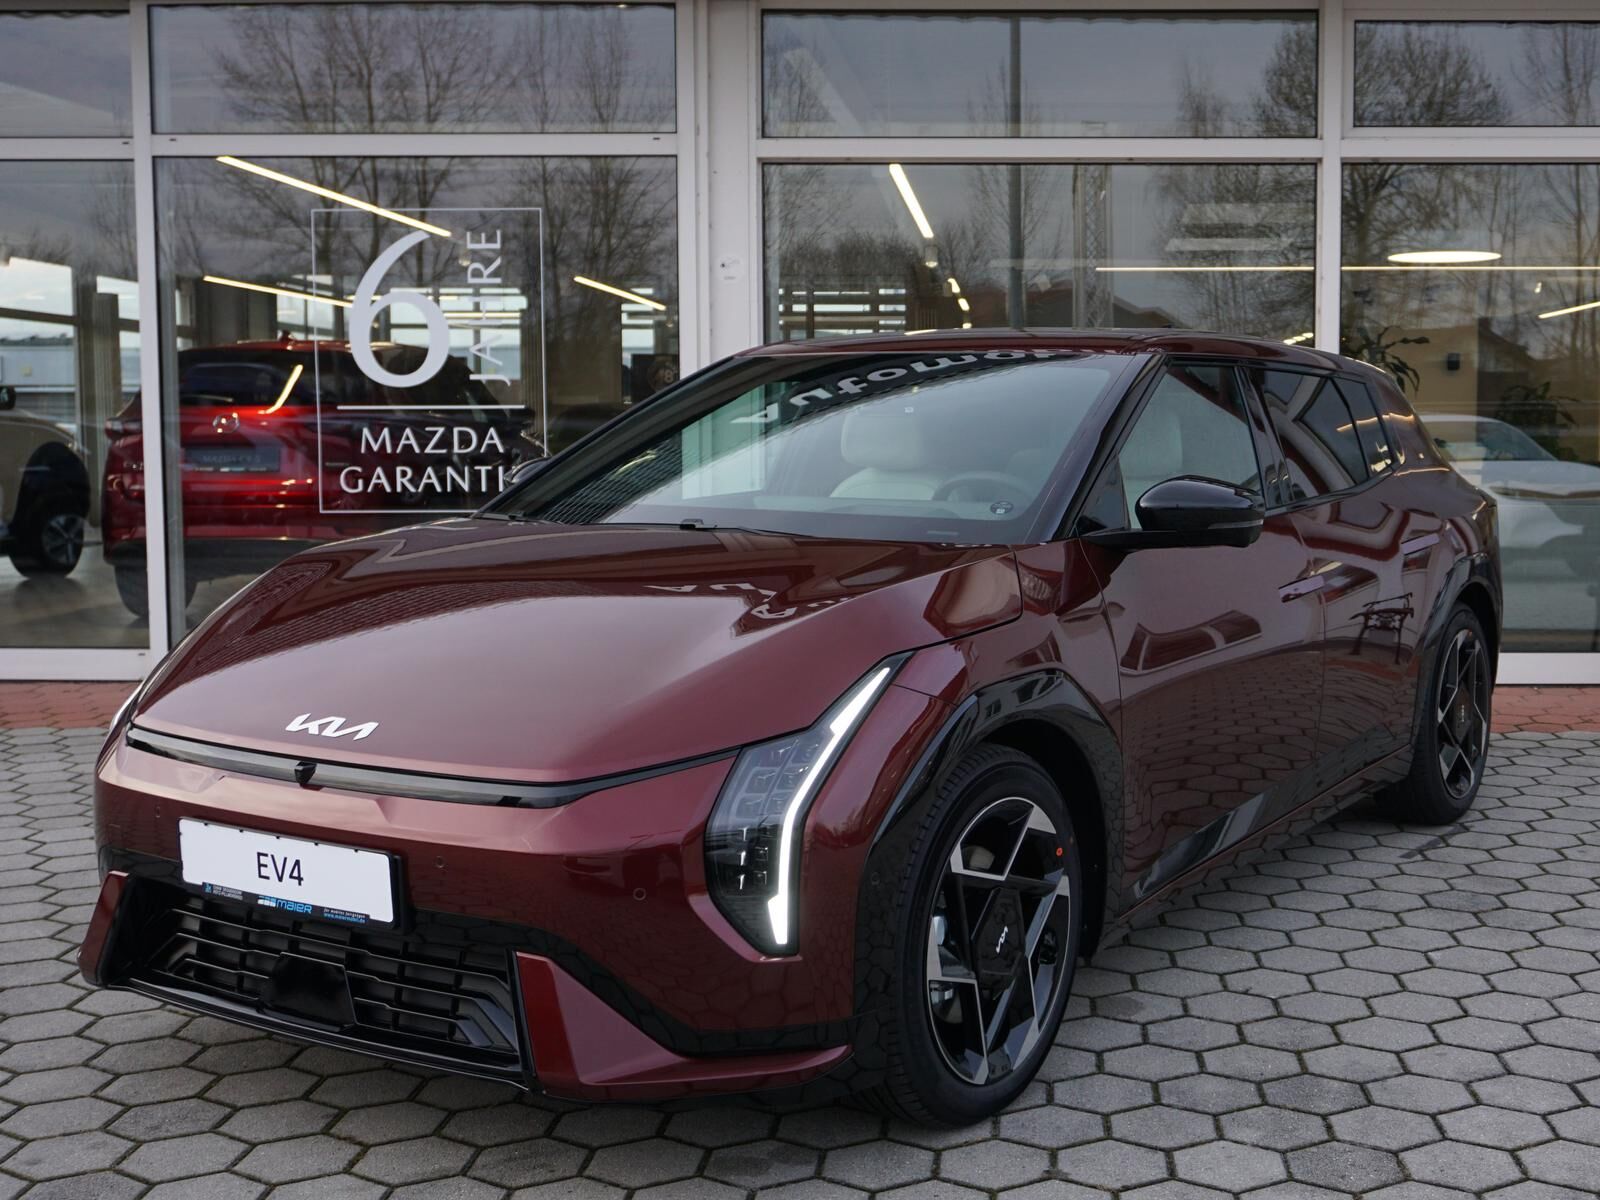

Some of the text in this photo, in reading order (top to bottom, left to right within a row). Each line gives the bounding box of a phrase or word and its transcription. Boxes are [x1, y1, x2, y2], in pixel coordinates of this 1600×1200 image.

[349, 229, 451, 388] 6
[466, 229, 511, 387] JAHRE
[360, 426, 505, 454] MAZDA
[339, 465, 505, 494] GARANTI
[285, 712, 379, 741] KIA
[256, 851, 304, 886] EV4
